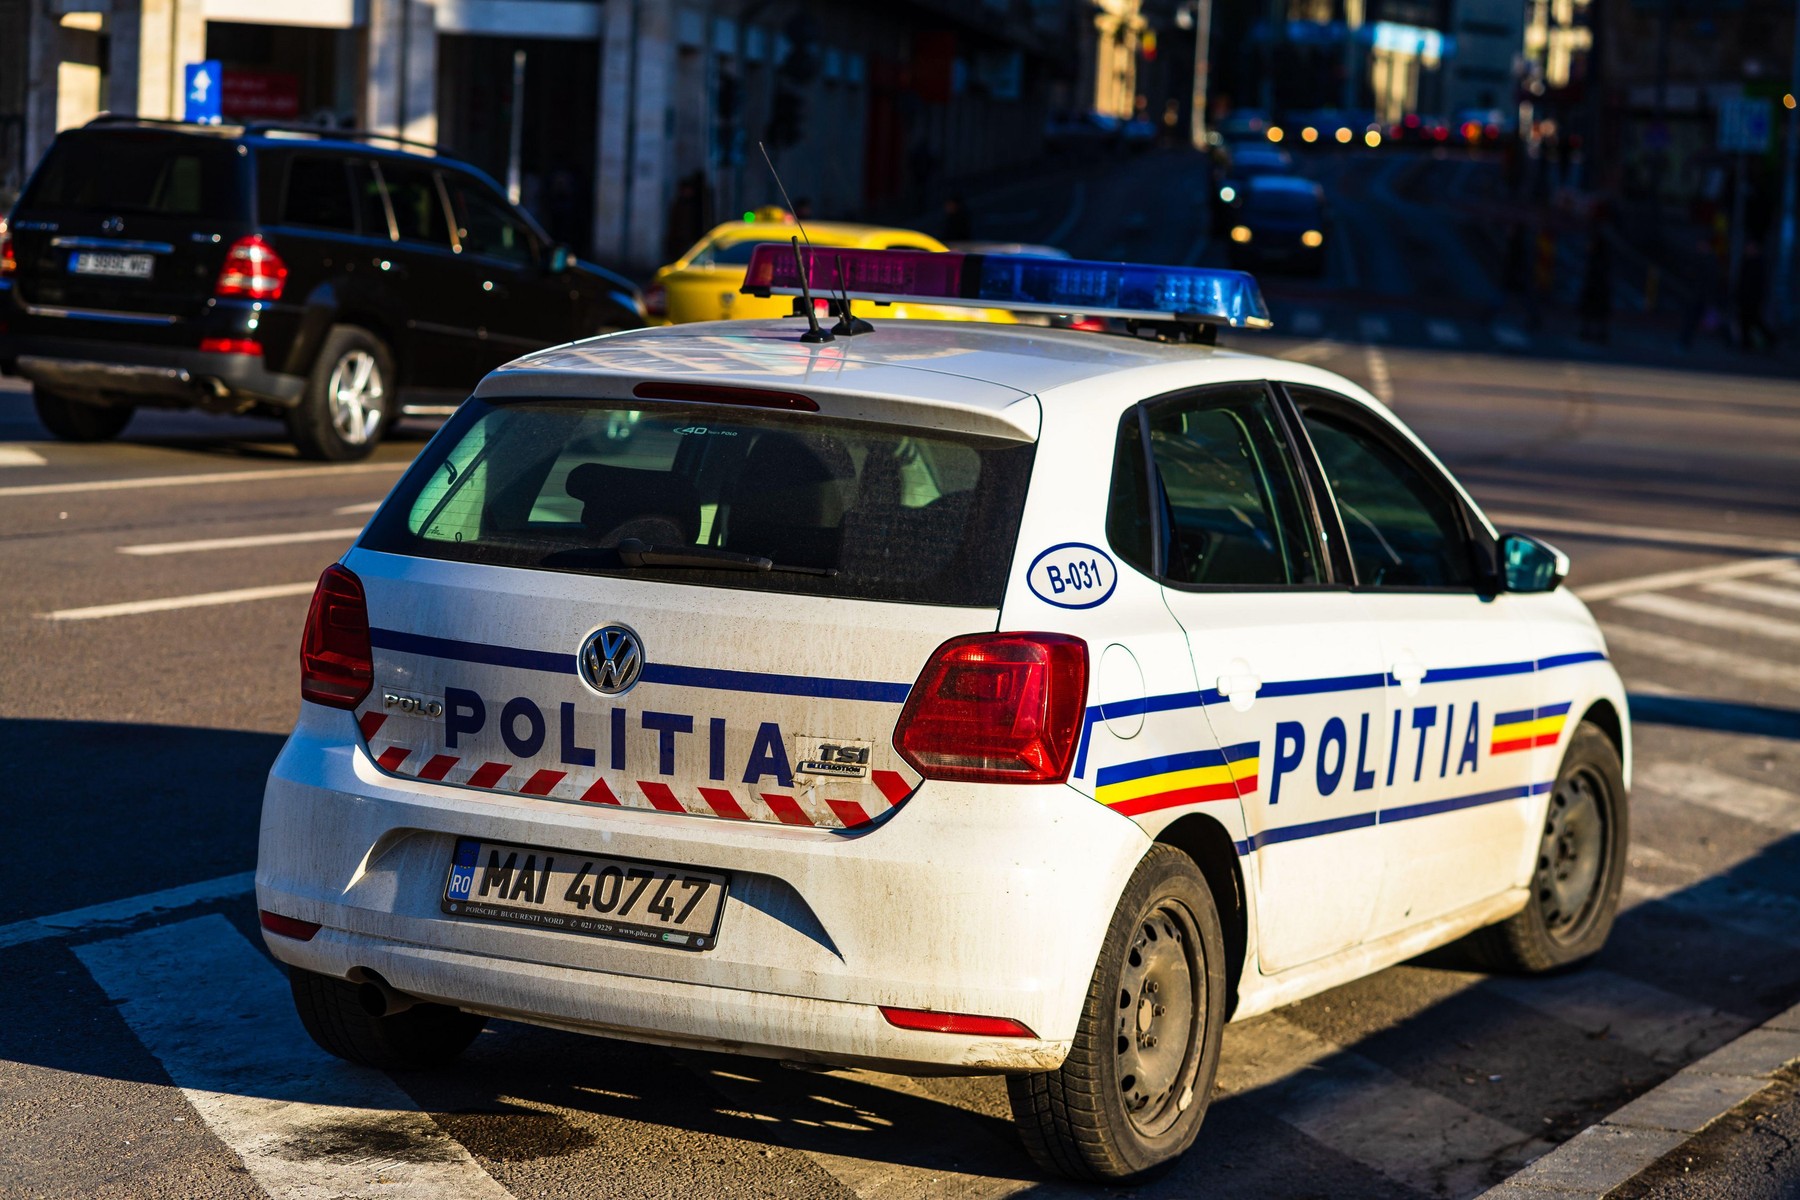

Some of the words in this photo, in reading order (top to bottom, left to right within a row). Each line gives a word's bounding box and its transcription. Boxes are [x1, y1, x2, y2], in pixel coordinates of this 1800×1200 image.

[682, 427, 708, 435] 40
[1046, 559, 1102, 594] B-031
[582, 626, 641, 693] VW
[384, 693, 443, 718] POLO
[445, 687, 795, 789] POLITIA
[1269, 701, 1479, 805] POLITIA
[818, 743, 870, 765] TSI
[451, 874, 471, 894] RO
[478, 849, 555, 905] MAI
[564, 861, 712, 925] 40747
[465, 906, 498, 917] PORSCHE
[500, 910, 541, 922] BUCURESTI
[543, 916, 564, 925] NORD
[597, 923, 613, 932] 9229
